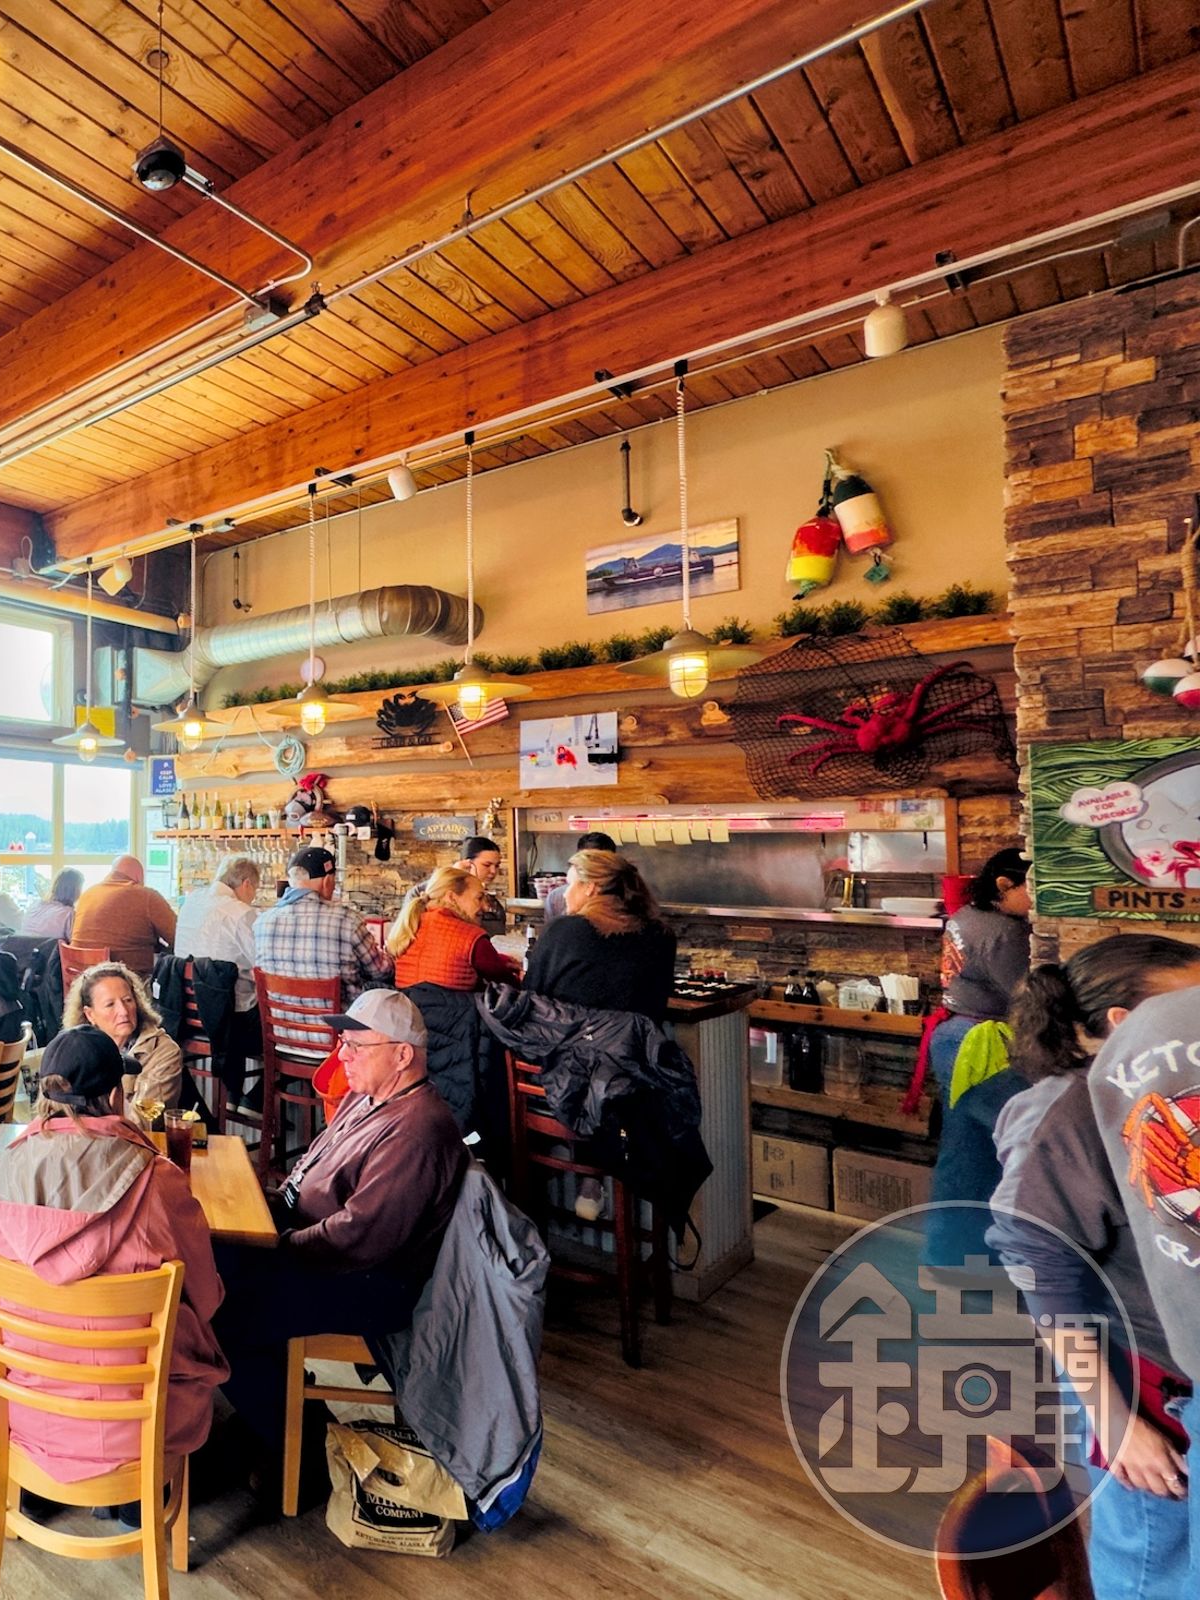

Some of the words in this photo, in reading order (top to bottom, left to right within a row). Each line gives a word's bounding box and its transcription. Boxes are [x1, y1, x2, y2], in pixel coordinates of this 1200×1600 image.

[1077, 790, 1131, 808] AVAILABLE
[1095, 802, 1115, 812] FOR
[1090, 806, 1139, 822] PURCHASE
[1108, 890, 1185, 909] PINTS
[1155, 1233, 1200, 1268] CR
[375, 1505, 424, 1518] COMPANY
